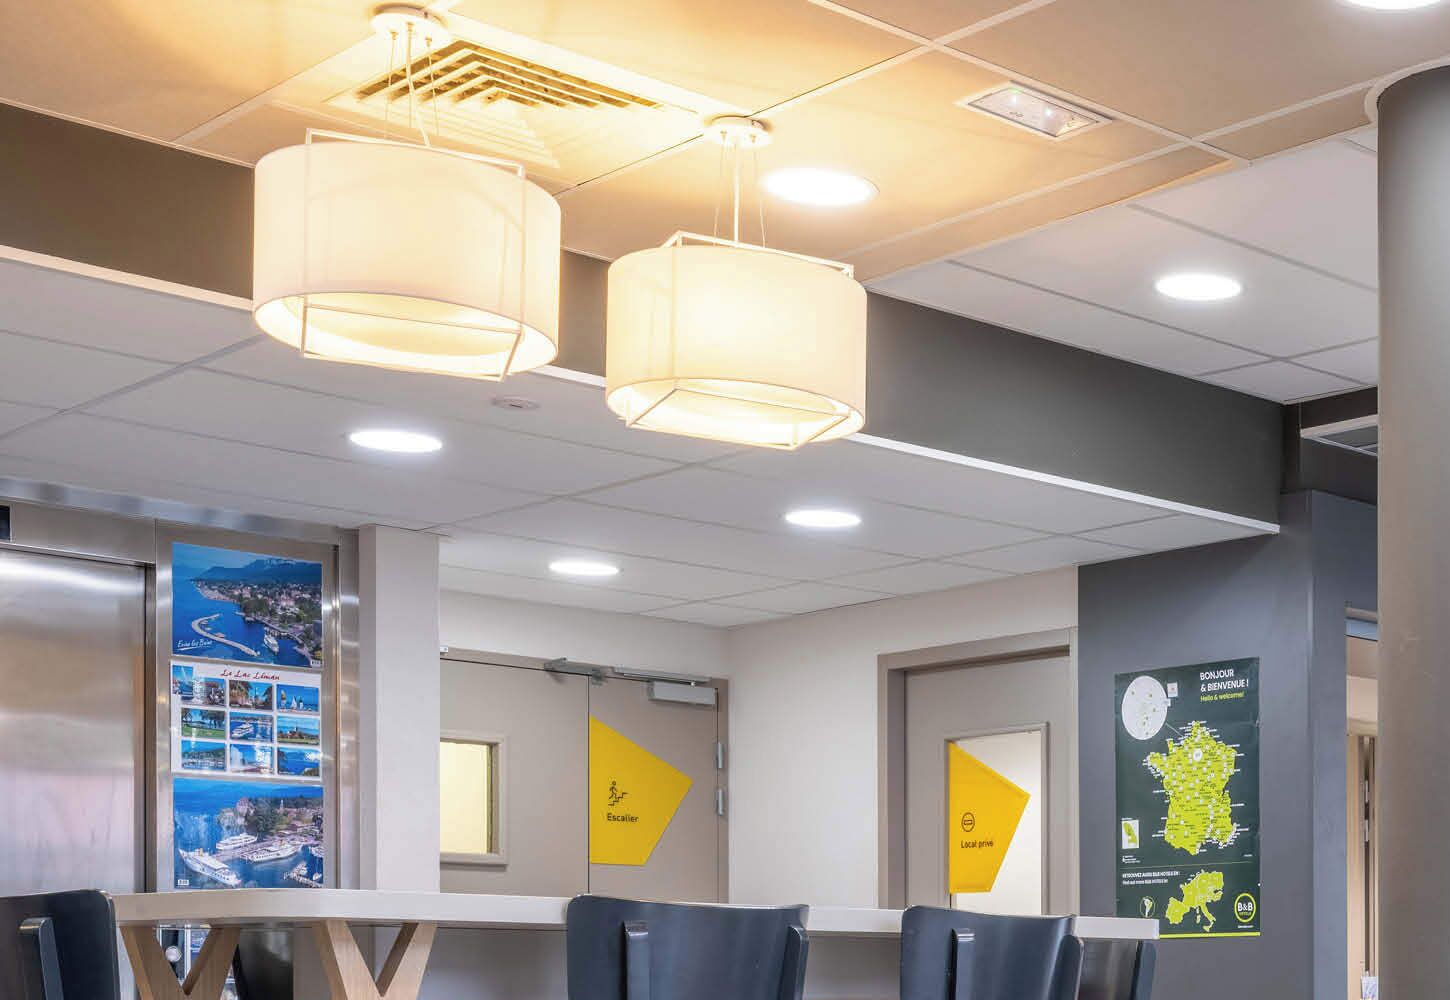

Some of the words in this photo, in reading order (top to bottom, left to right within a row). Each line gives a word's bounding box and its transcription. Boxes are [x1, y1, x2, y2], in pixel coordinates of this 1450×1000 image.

[234, 670, 251, 678] Lac
[253, 672, 280, 680] Léman
[1200, 669, 1234, 680] BONJOUR
[1200, 683, 1206, 692] &
[1207, 679, 1245, 691] BIENVENUE
[607, 812, 639, 823] Escalier
[960, 840, 977, 849] Local
[1237, 902, 1253, 912] B&B
